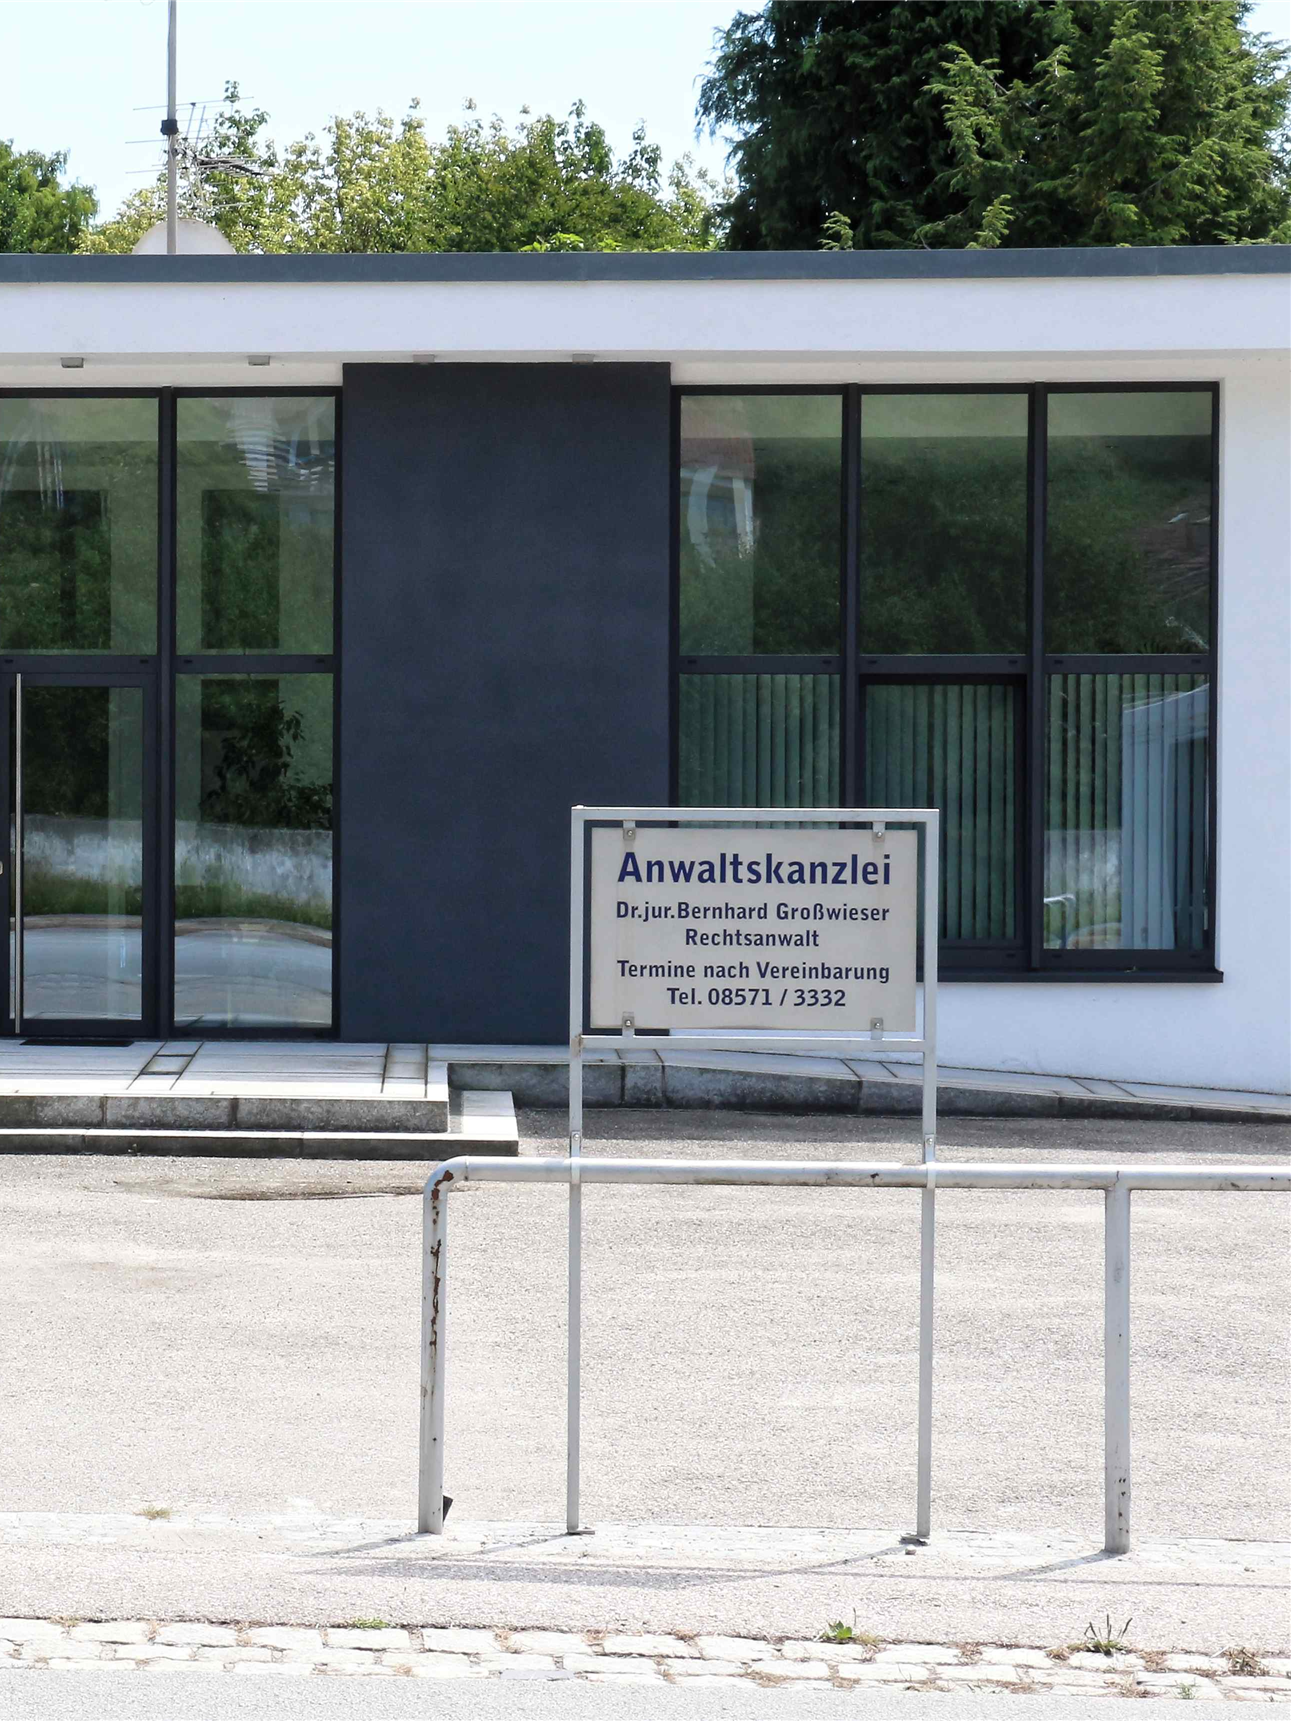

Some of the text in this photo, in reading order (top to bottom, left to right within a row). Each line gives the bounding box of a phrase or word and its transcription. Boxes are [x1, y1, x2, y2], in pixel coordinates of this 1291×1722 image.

[617, 851, 891, 885] Anwaltskanzlei
[776, 902, 890, 921] Großwieser
[685, 928, 820, 947] Rechtsanwalt
[616, 959, 890, 984] Termine nach Vereinbarung
[666, 987, 847, 1007] Tel. 08571 / 3332
